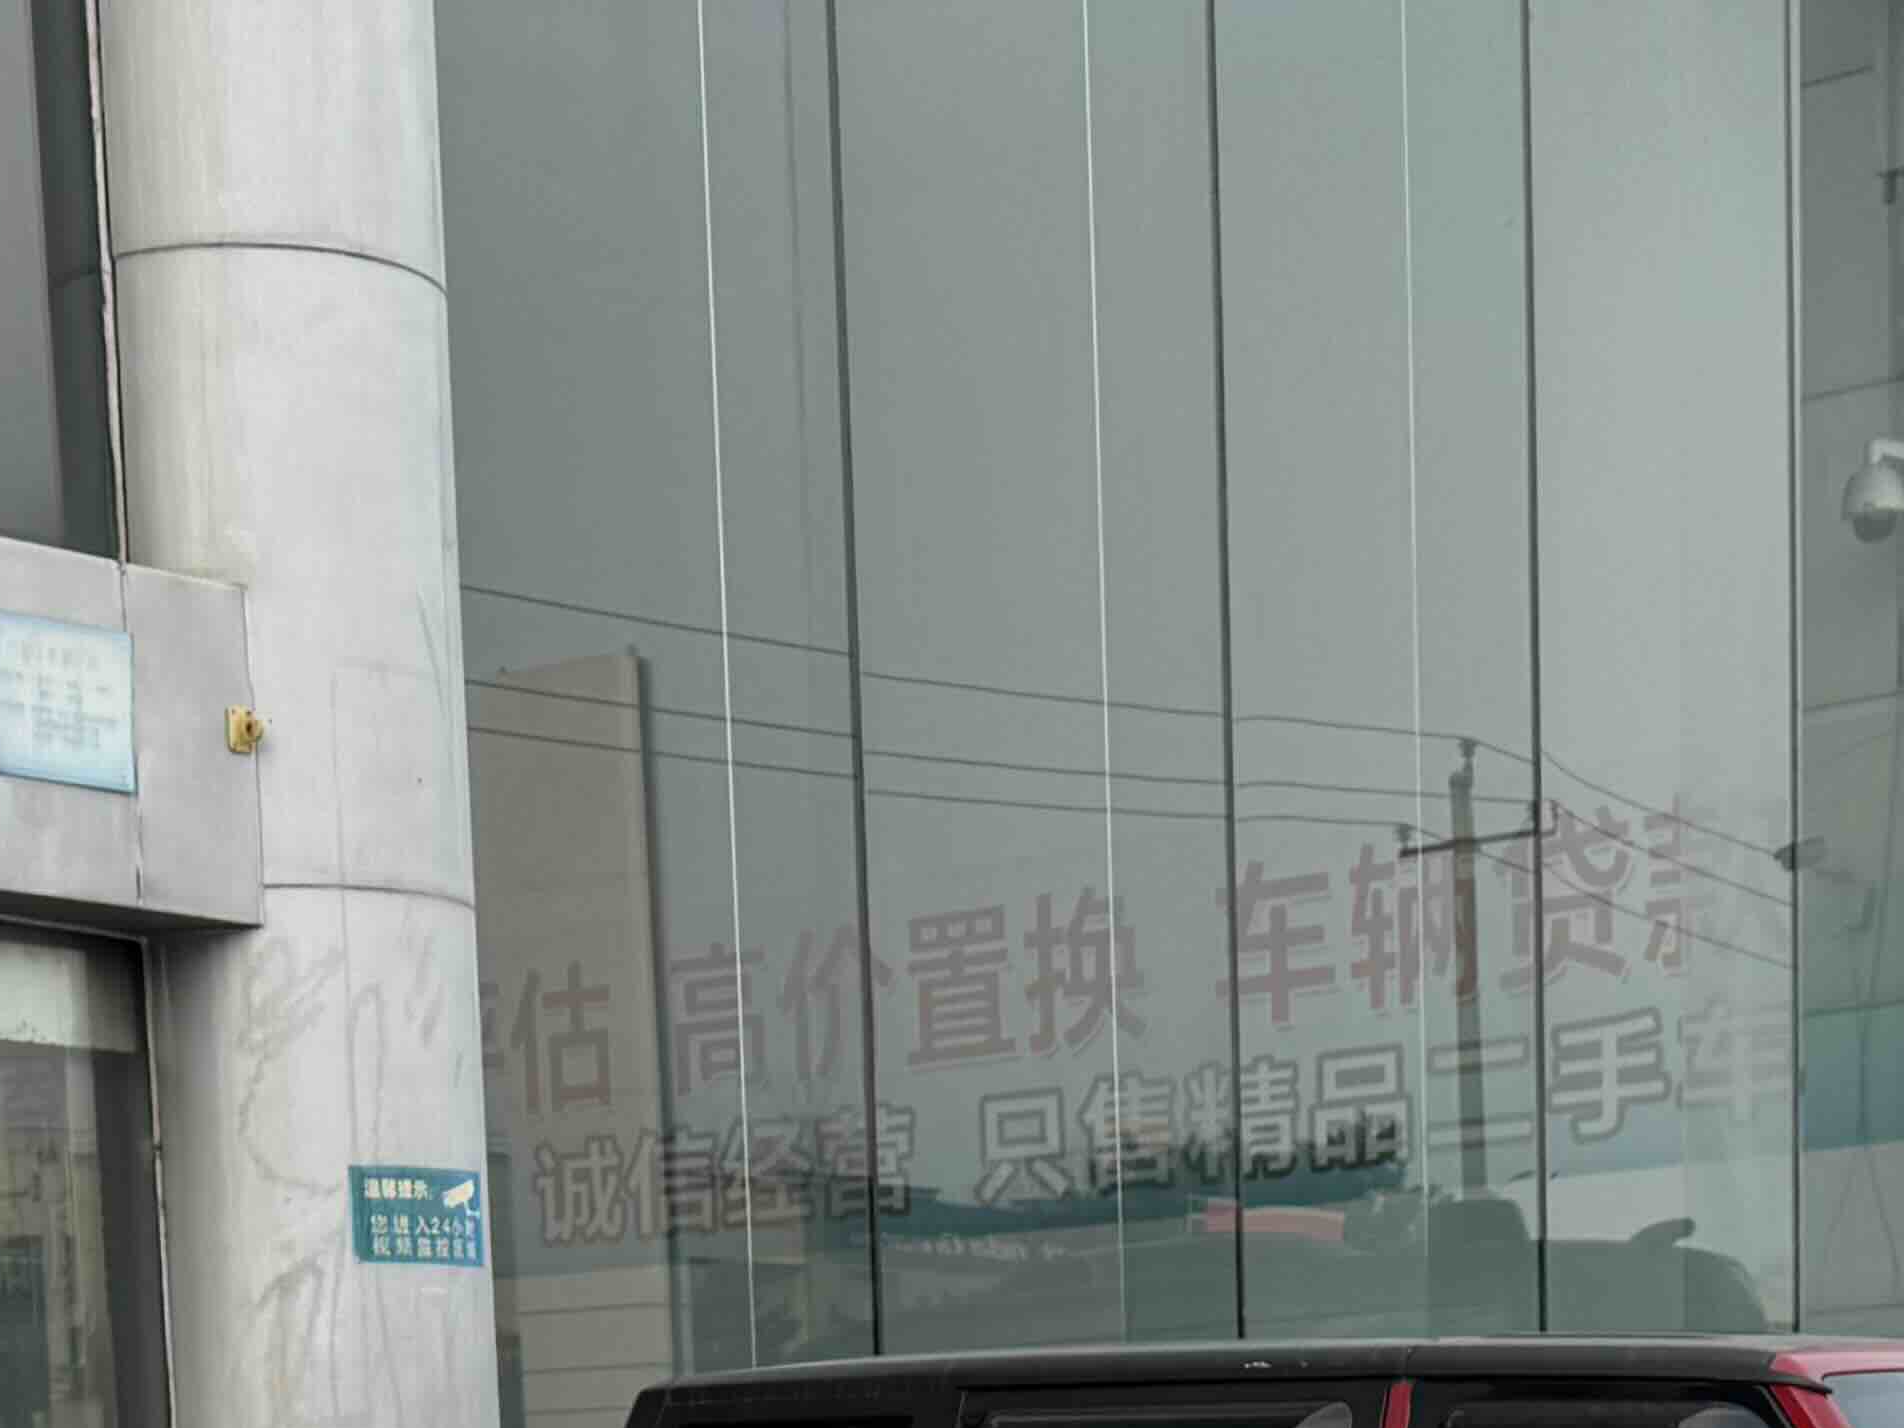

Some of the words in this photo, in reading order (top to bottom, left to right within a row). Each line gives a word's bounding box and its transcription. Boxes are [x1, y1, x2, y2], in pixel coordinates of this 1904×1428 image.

[480, 958, 611, 1114] 估
[668, 886, 1148, 1096] 高价置换
[534, 1102, 917, 1246] 诚信经营
